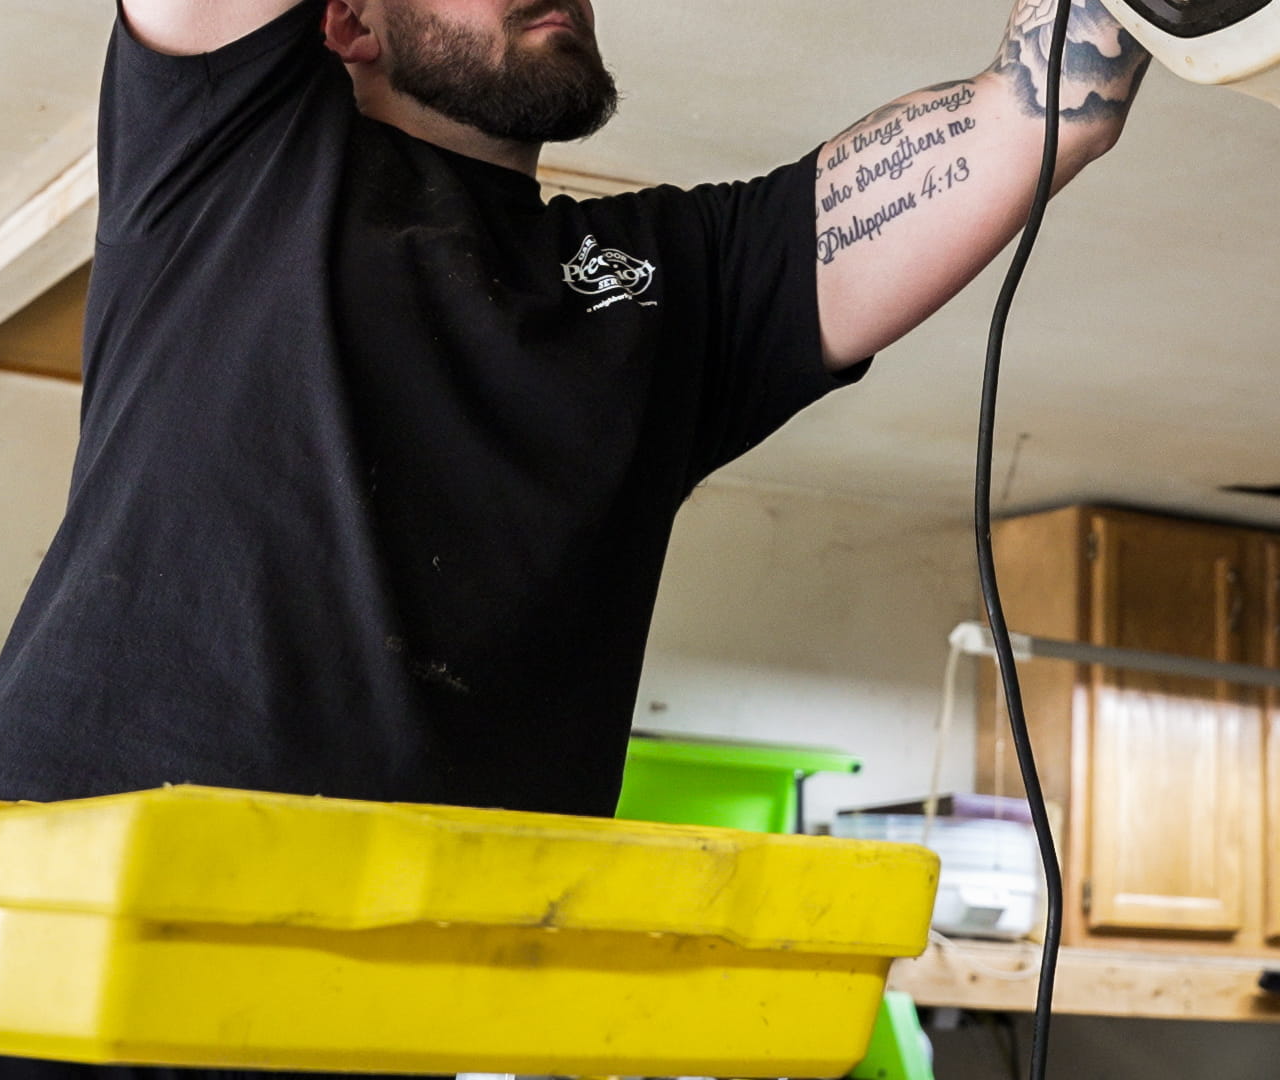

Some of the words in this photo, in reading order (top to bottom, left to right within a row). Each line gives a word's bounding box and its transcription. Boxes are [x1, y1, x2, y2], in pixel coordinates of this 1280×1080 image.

[821, 174, 853, 213] who
[856, 129, 946, 193] strengthens
[948, 115, 977, 141] me
[827, 146, 850, 171] all
[852, 118, 904, 153] things
[904, 85, 975, 123] through
[816, 191, 917, 266] Philippians
[921, 156, 971, 201] 4:13
